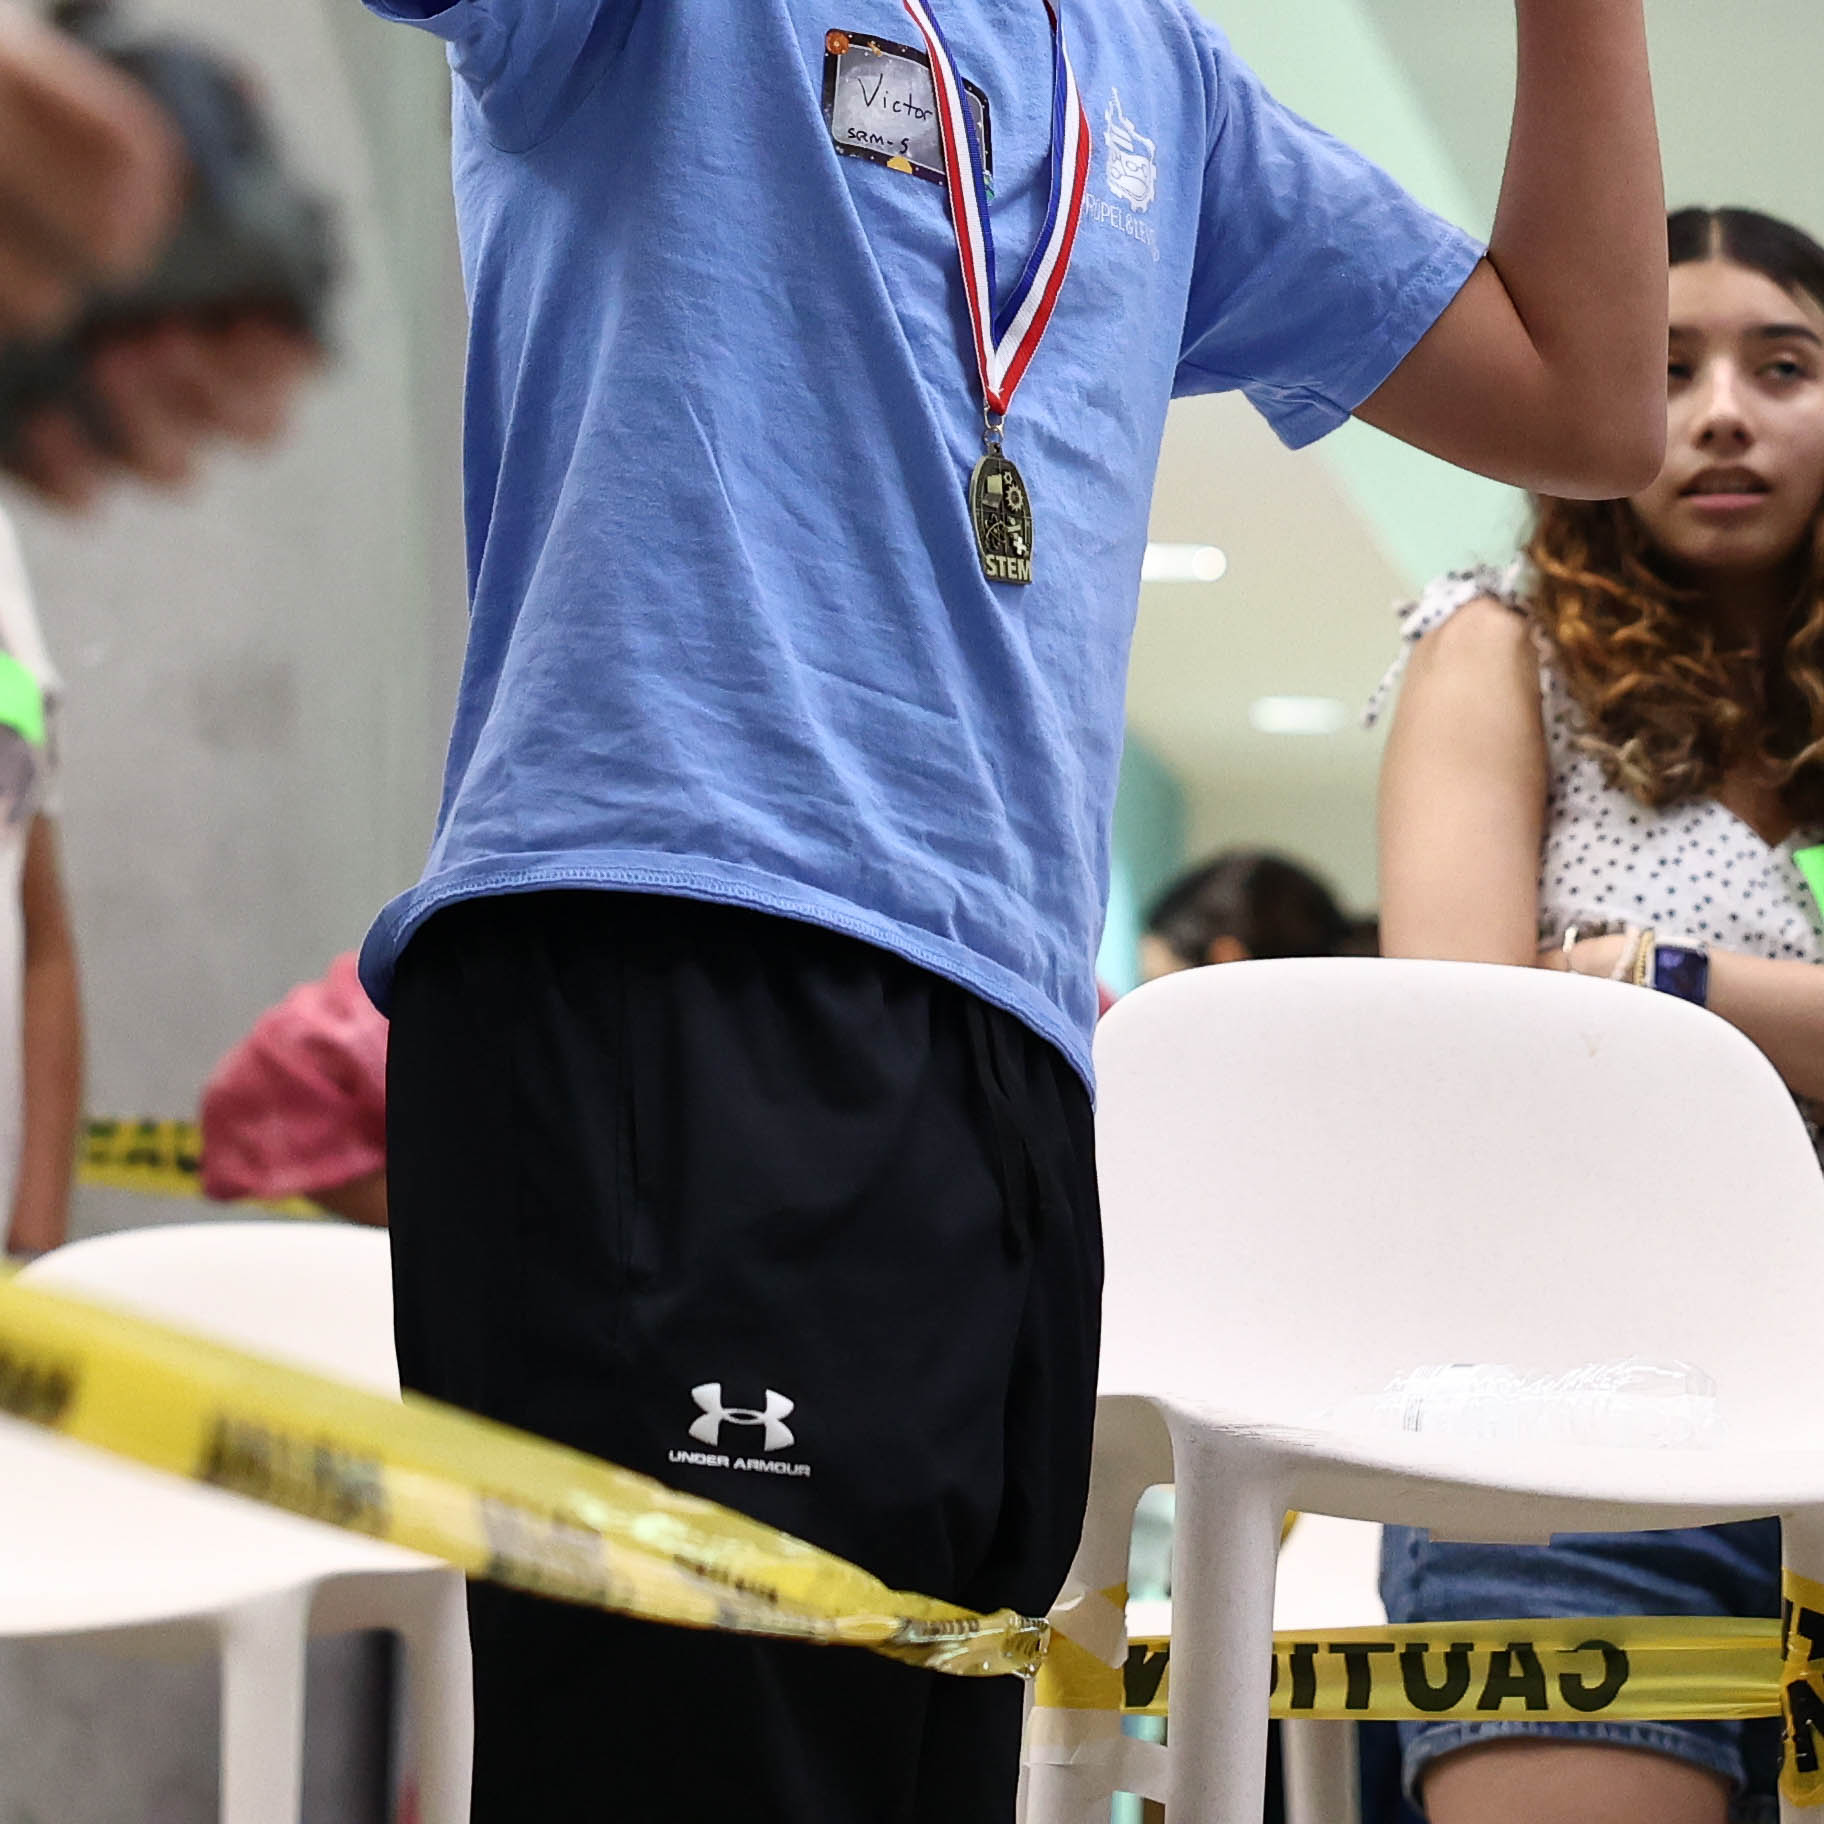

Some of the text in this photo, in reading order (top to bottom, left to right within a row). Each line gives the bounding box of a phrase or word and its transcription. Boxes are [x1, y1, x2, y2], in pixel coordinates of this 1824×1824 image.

[857, 73, 933, 121] Victor
[985, 554, 1033, 581] STEM
[668, 1449, 811, 1477] UNDER ARMOUR
